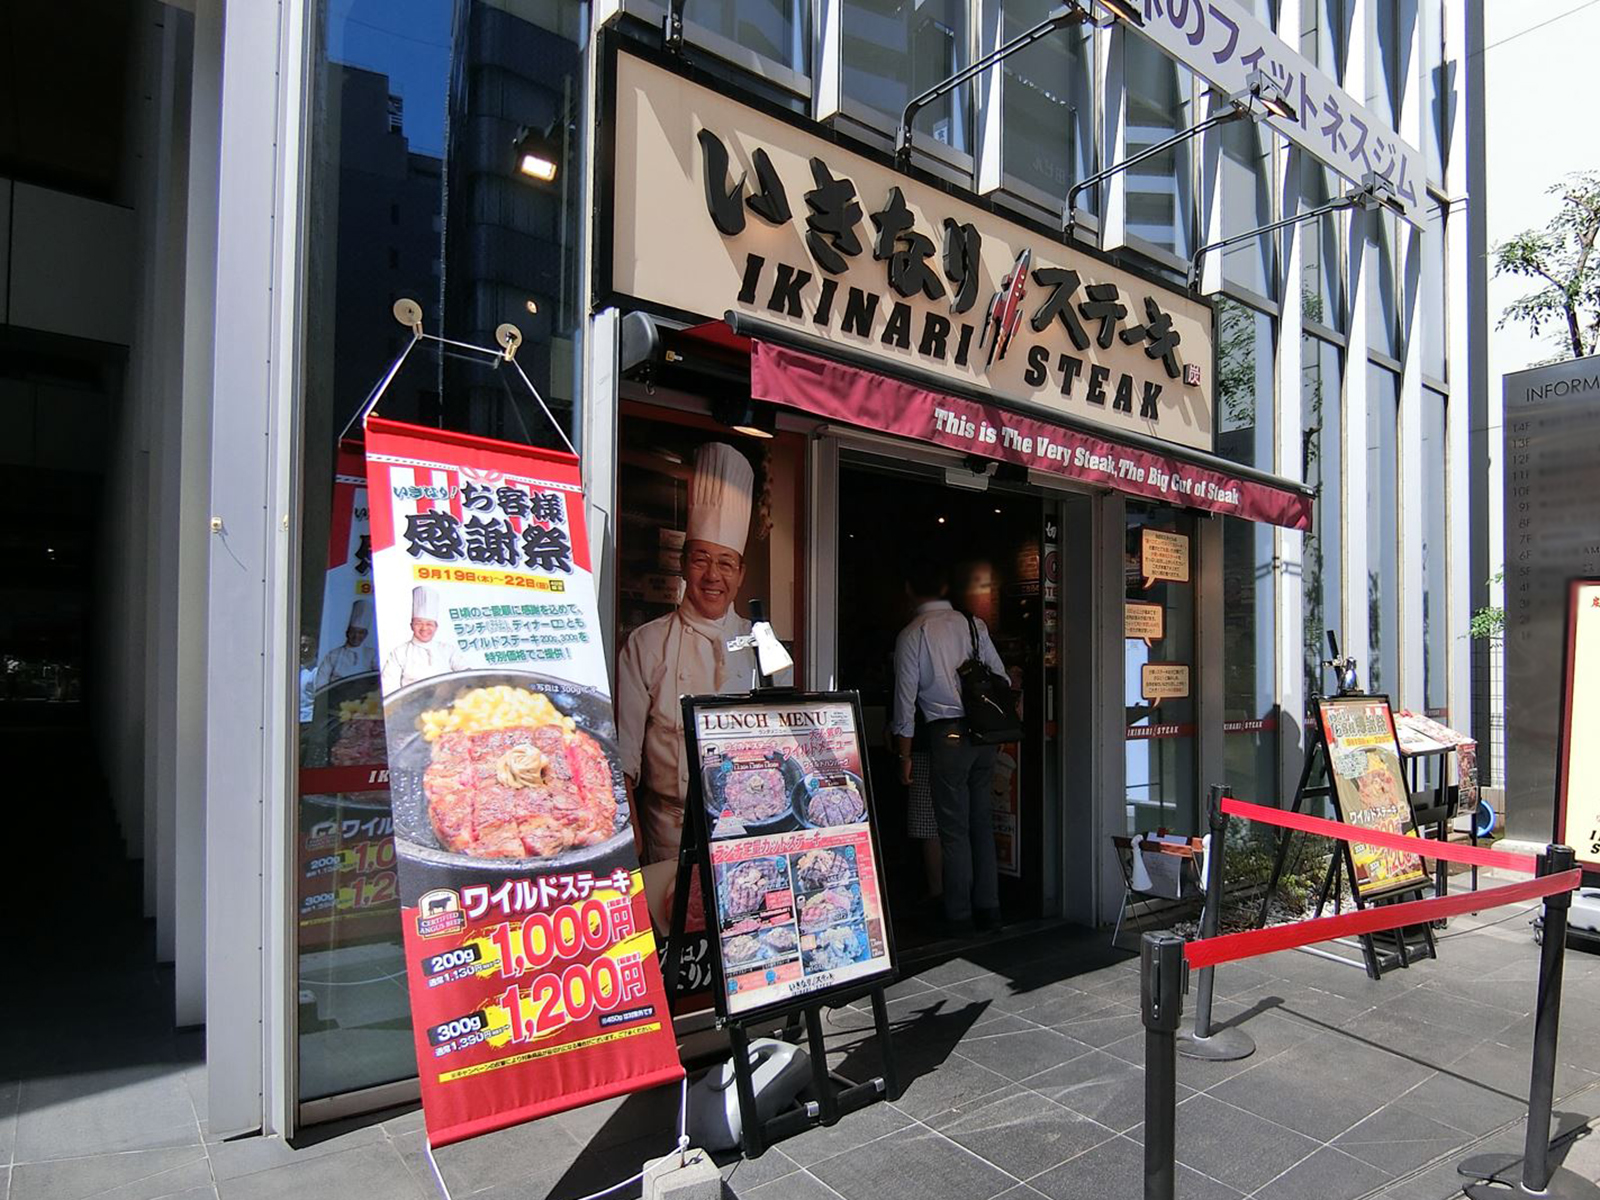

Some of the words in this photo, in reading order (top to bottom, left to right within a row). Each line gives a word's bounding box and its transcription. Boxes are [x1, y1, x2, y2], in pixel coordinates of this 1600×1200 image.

[697, 129, 982, 314] いきなり
[1031, 267, 1182, 379] ステーキ
[737, 254, 974, 366] IKINARI
[1024, 345, 1164, 421] STEAK
[1526, 374, 1600, 402] INFORM
[934, 408, 975, 438] This
[979, 421, 997, 443] is
[1002, 427, 1032, 453] The
[1037, 436, 1072, 467] Very
[1118, 459, 1145, 482] The
[1148, 467, 1169, 493] Big
[1171, 474, 1191, 494] Cut
[1194, 478, 1207, 496] of
[1207, 481, 1239, 505] Steak
[460, 480, 566, 525] お客様
[403, 509, 574, 574] 感謝祭
[703, 713, 769, 730] LUNCH
[777, 711, 827, 728] MENU
[464, 869, 632, 918] ワイルドステーキ
[431, 949, 475, 973] 200g
[490, 900, 635, 979] 1,000円
[437, 1015, 481, 1042] 300g
[501, 957, 647, 1044] 1,200円
